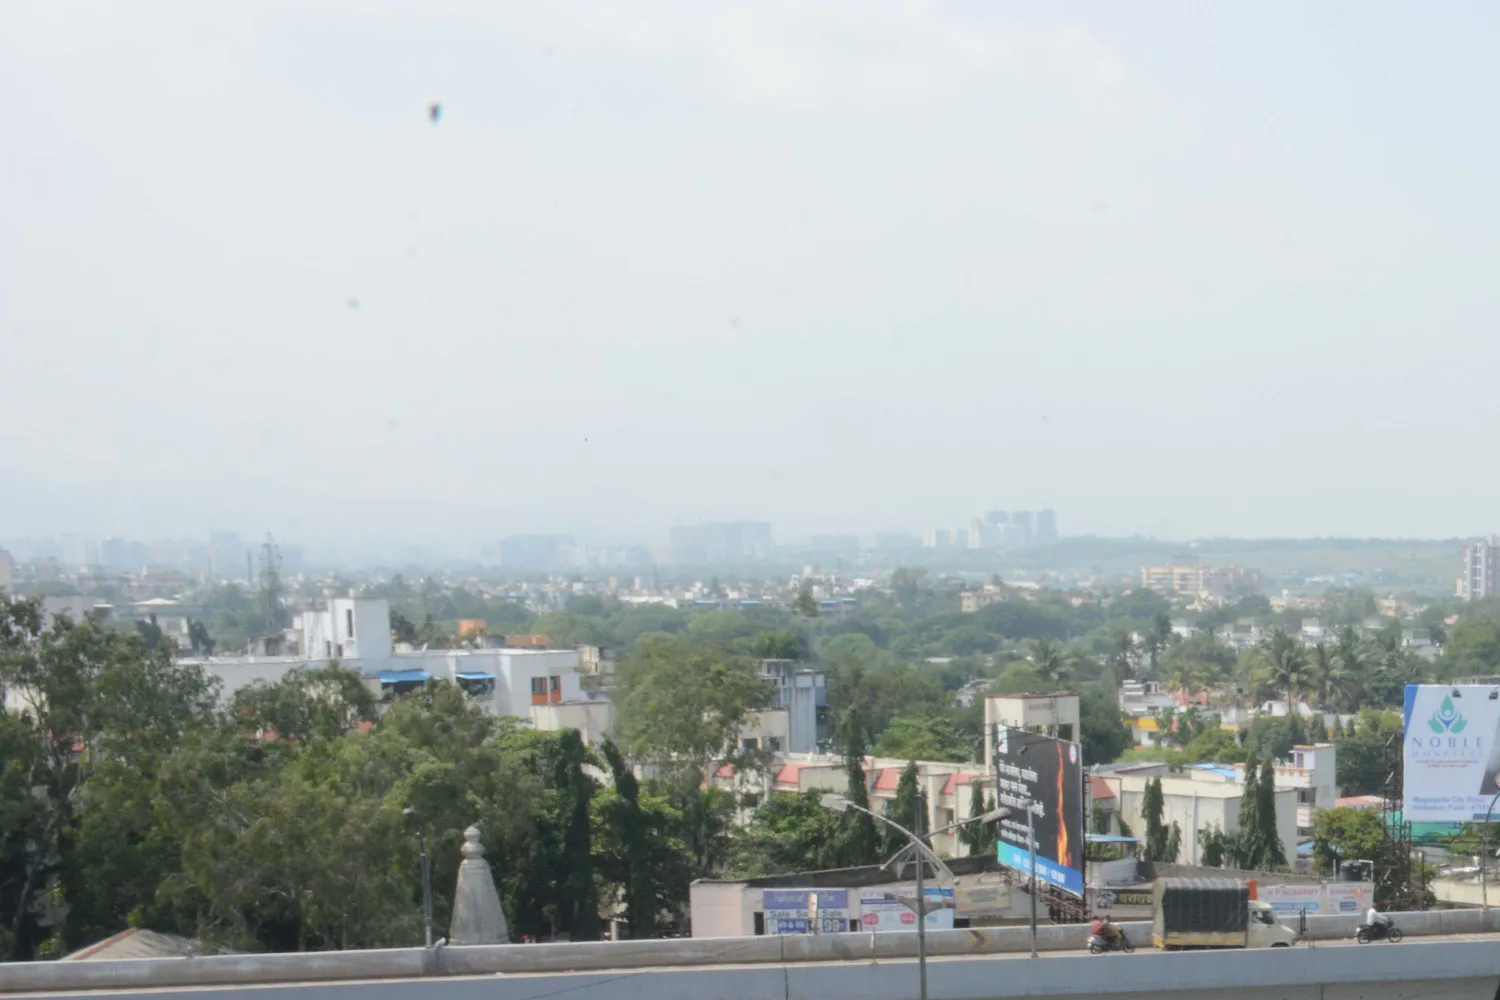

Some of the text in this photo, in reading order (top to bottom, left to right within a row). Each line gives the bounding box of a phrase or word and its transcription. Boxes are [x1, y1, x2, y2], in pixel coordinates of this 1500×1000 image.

[1412, 736, 1483, 748] NOBLE
[1412, 750, 1484, 758] HOSPITAL
[769, 910, 791, 918] Sale
